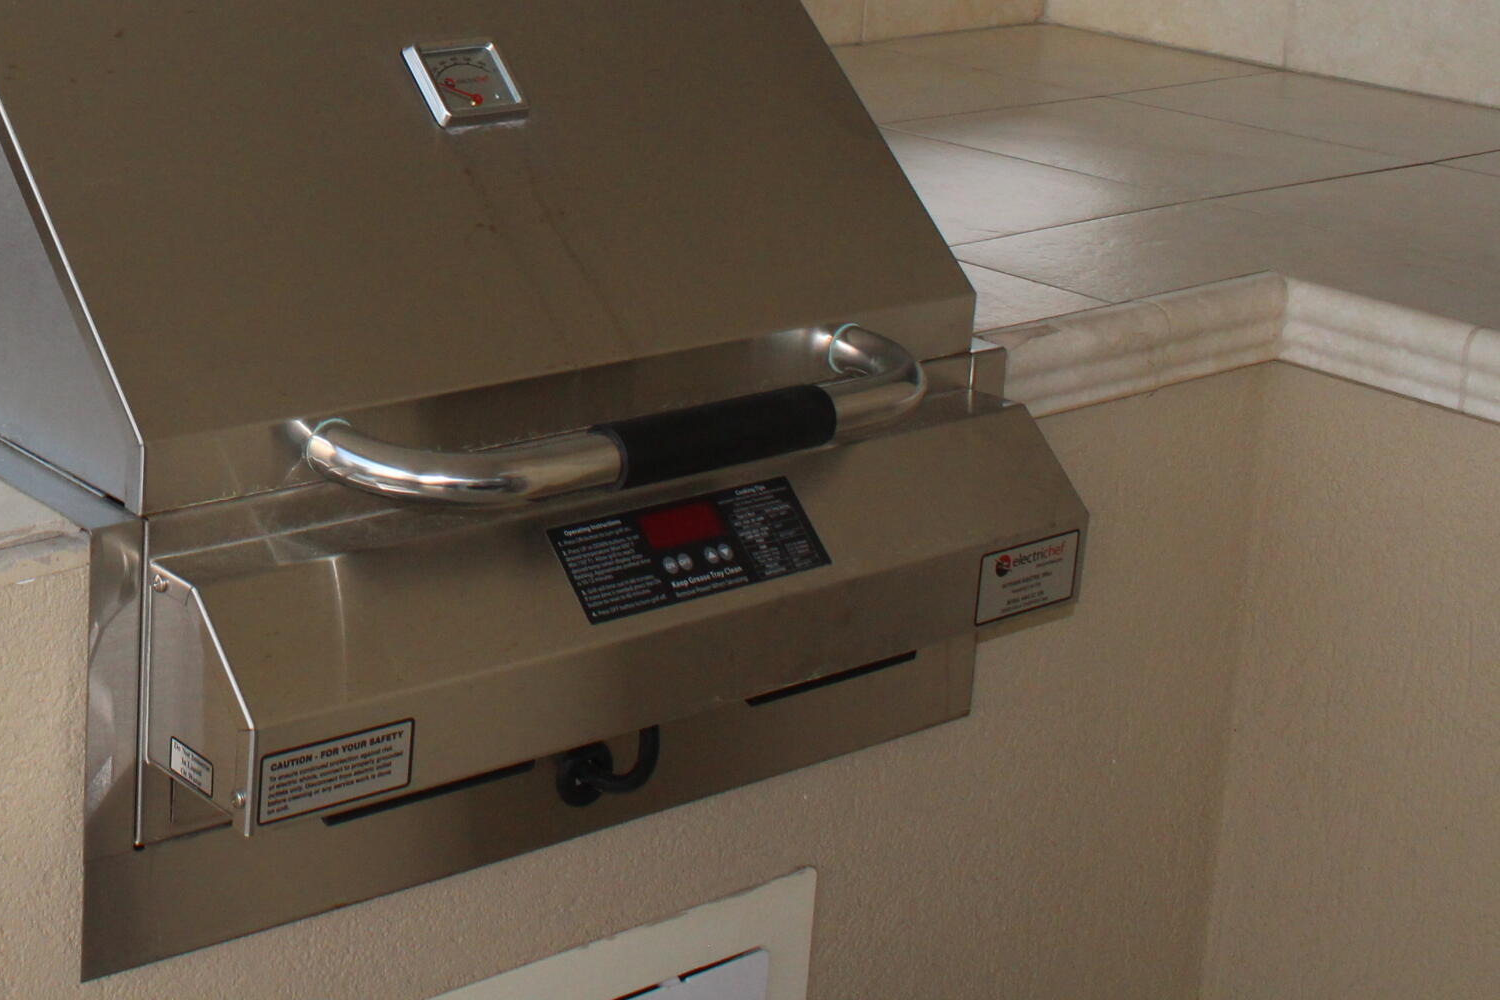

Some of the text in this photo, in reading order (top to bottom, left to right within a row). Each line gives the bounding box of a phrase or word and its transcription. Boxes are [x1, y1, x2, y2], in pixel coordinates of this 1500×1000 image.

[671, 565, 743, 589] Keep Grease Tray Clean
[270, 754, 312, 772] CAUTION
[320, 746, 338, 759] FOR
[342, 740, 366, 753] YOUR
[369, 730, 403, 746] SAFETY
